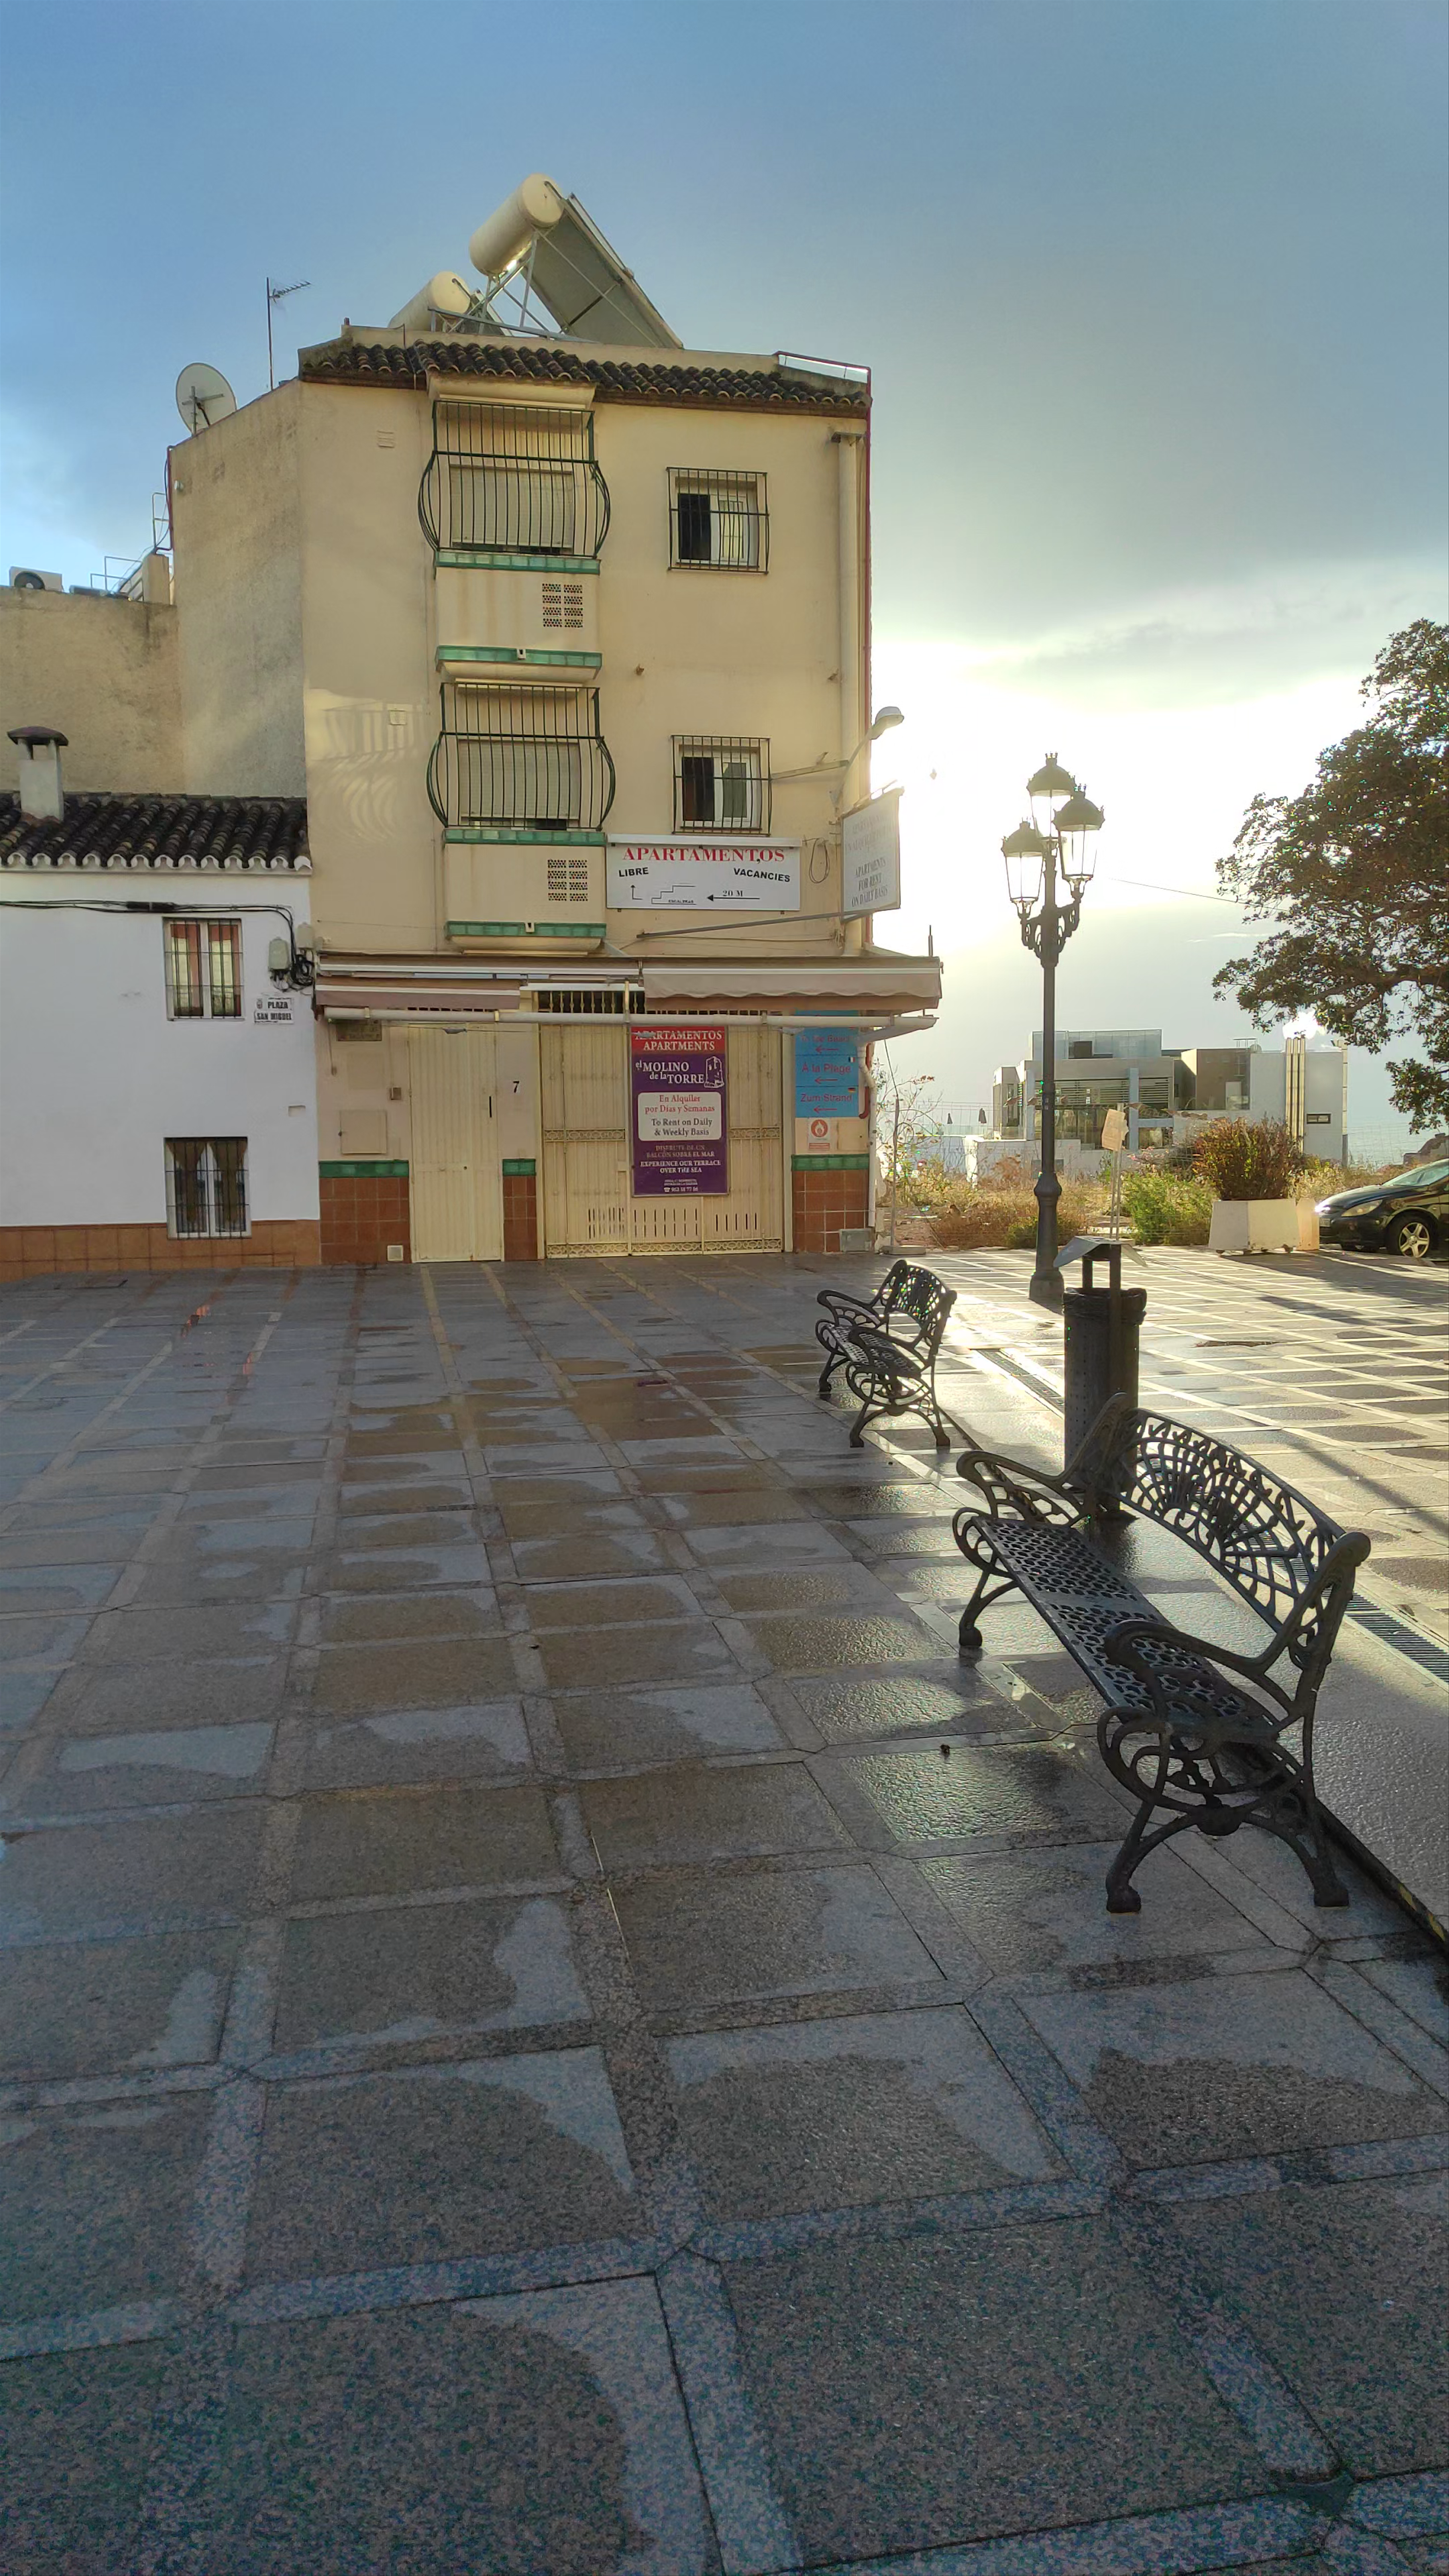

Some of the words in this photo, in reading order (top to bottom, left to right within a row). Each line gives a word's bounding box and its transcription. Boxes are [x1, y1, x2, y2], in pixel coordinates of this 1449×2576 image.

[623, 847, 784, 861] APARTAMENTOS
[618, 867, 649, 877] LIBRE
[734, 868, 791, 882] VACANCIES
[859, 878, 868, 891] FOR
[870, 873, 881, 887] RENT
[852, 897, 859, 907] ON
[643, 1041, 715, 1050] APARTMENTS
[635, 1060, 642, 1068] el
[643, 1062, 689, 1072] MOLINO
[823, 1064, 851, 1075] Plage
[667, 1074, 705, 1084] TORRE
[513, 1081, 519, 1093] 7
[672, 1095, 701, 1104] Alquiler
[694, 1118, 712, 1127] Daily
[663, 1128, 689, 1137] Weekly
